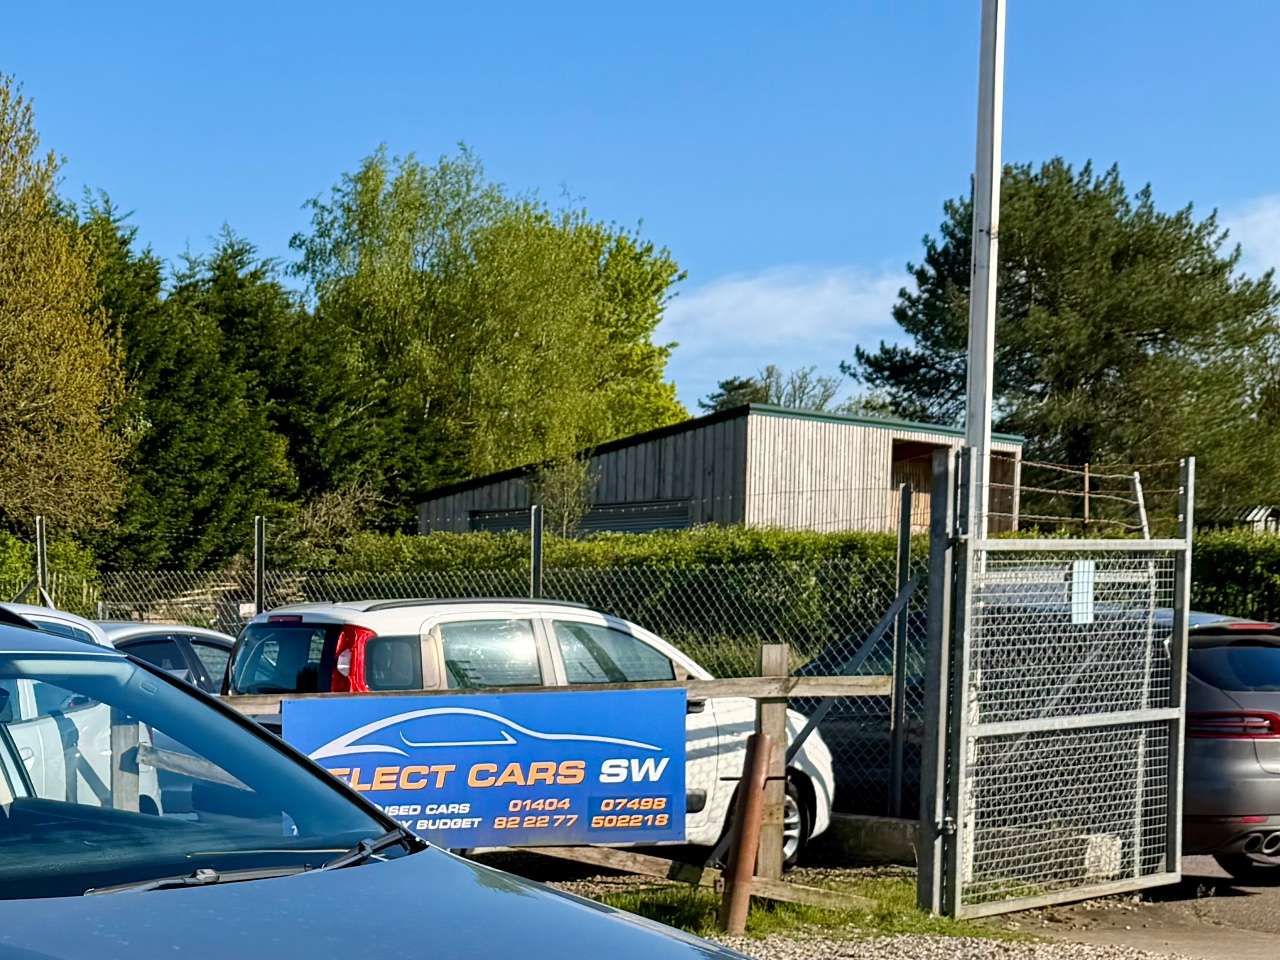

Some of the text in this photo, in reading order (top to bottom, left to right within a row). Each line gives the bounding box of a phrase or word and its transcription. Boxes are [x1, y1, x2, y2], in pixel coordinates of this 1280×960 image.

[327, 757, 670, 792] LECT CARS SW
[425, 803, 470, 815] CARS
[508, 798, 571, 812] 01404
[600, 797, 667, 811] 07498
[416, 818, 482, 830] BUDGET
[591, 814, 669, 828] 502218
